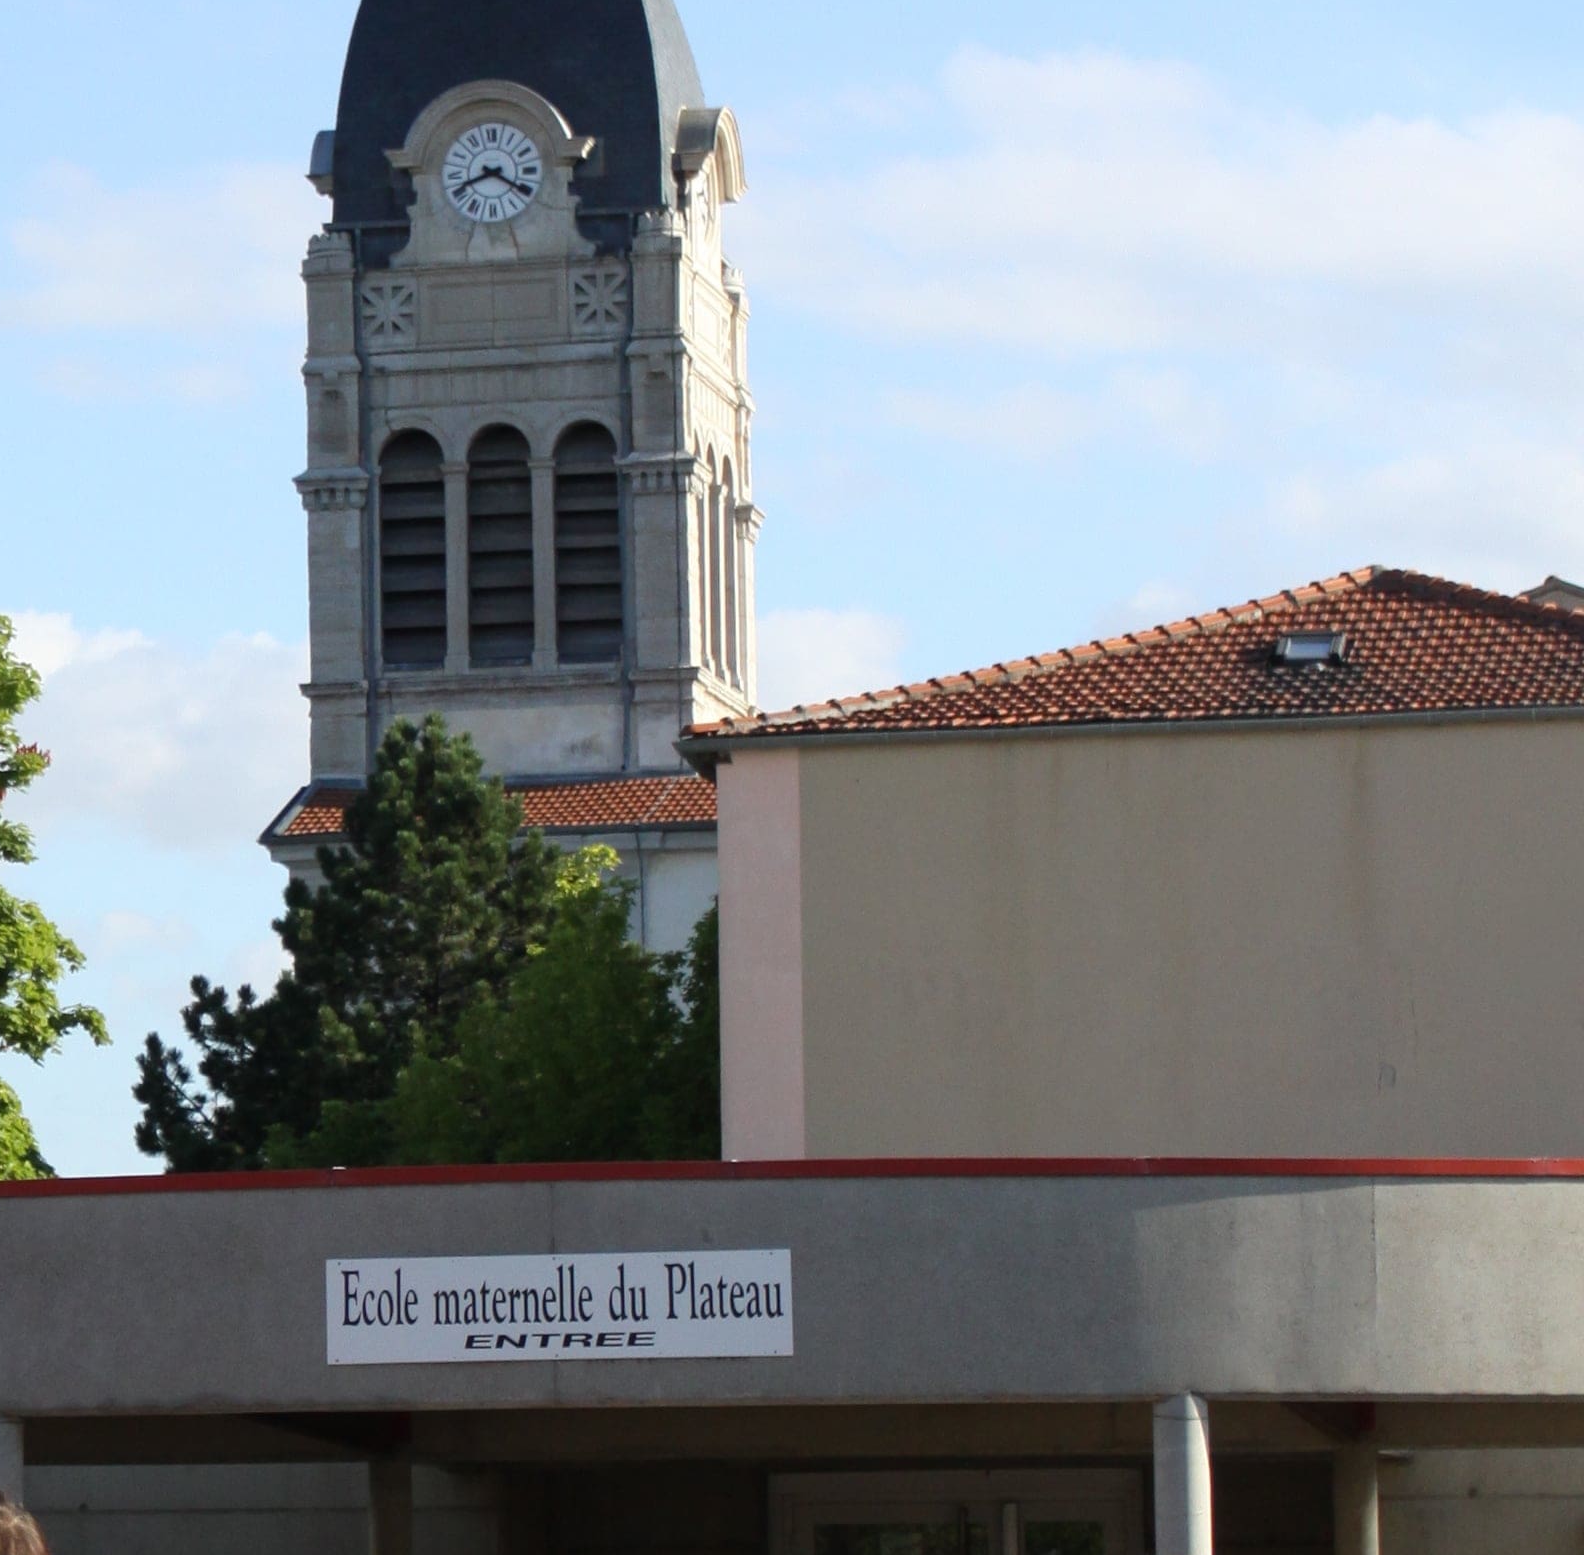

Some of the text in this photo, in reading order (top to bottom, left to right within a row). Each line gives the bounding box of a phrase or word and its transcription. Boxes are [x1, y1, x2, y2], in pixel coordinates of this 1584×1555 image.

[342, 1262, 783, 1326] Ecole maternelle du Plateau
[465, 1332, 656, 1349] ENTREE
